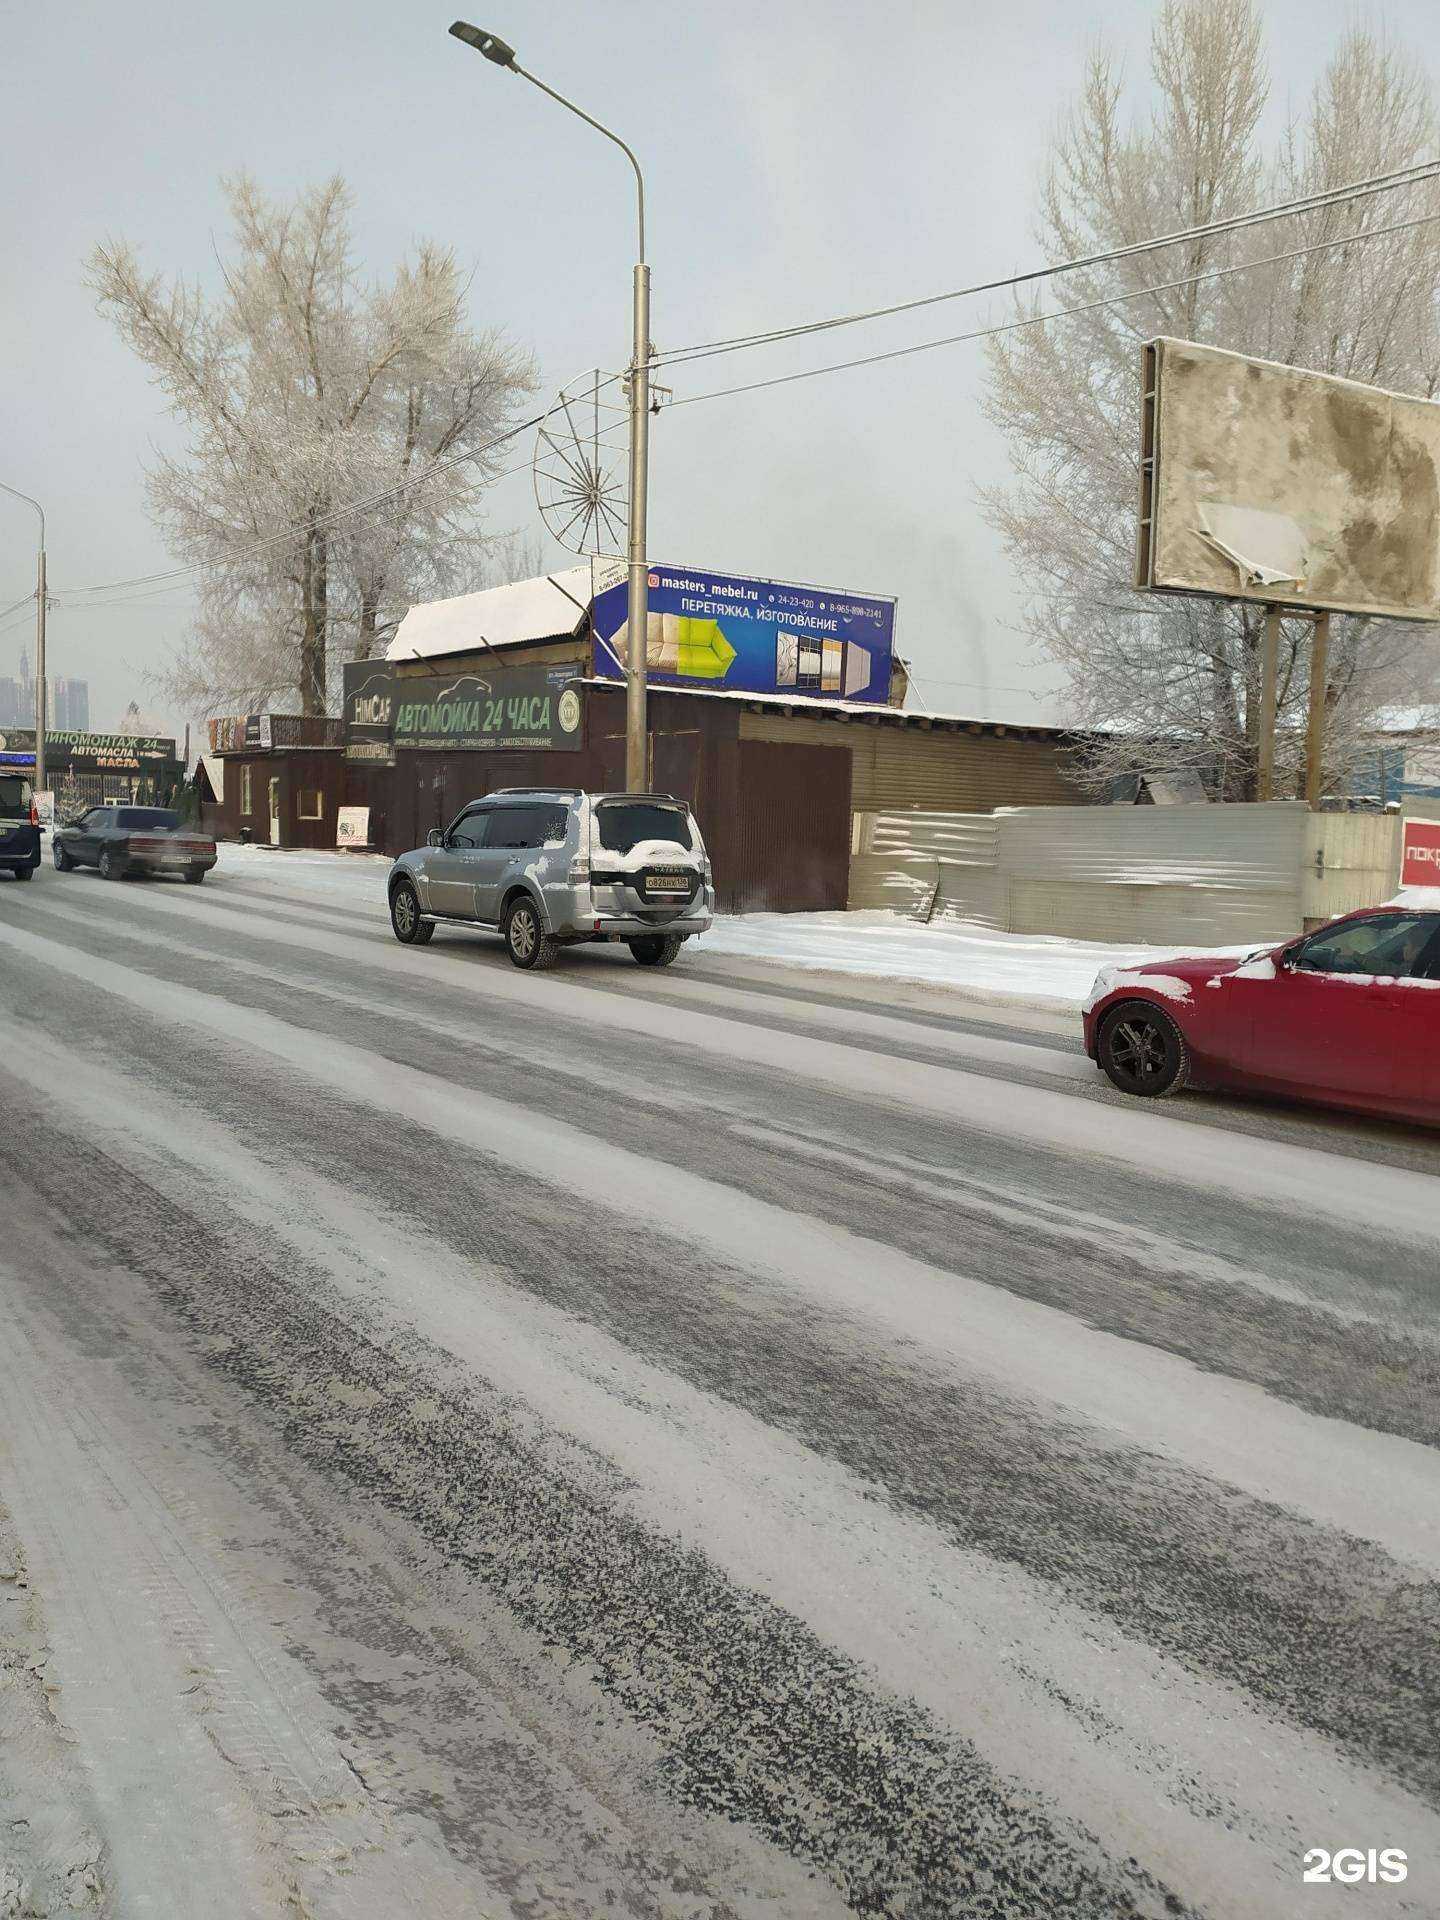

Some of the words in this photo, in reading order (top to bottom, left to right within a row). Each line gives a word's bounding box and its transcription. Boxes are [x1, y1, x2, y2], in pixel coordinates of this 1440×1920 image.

[661, 577, 759, 601] masters_mebel.ru
[681, 598, 754, 620] ПЕРЕТЯЖКА,
[395, 697, 479, 733] АВТОМОЙКА
[482, 700, 504, 731] 24
[506, 696, 550, 730] ЧАСА
[70, 745, 134, 758] АВТОМАСЛА
[143, 739, 158, 750] 24
